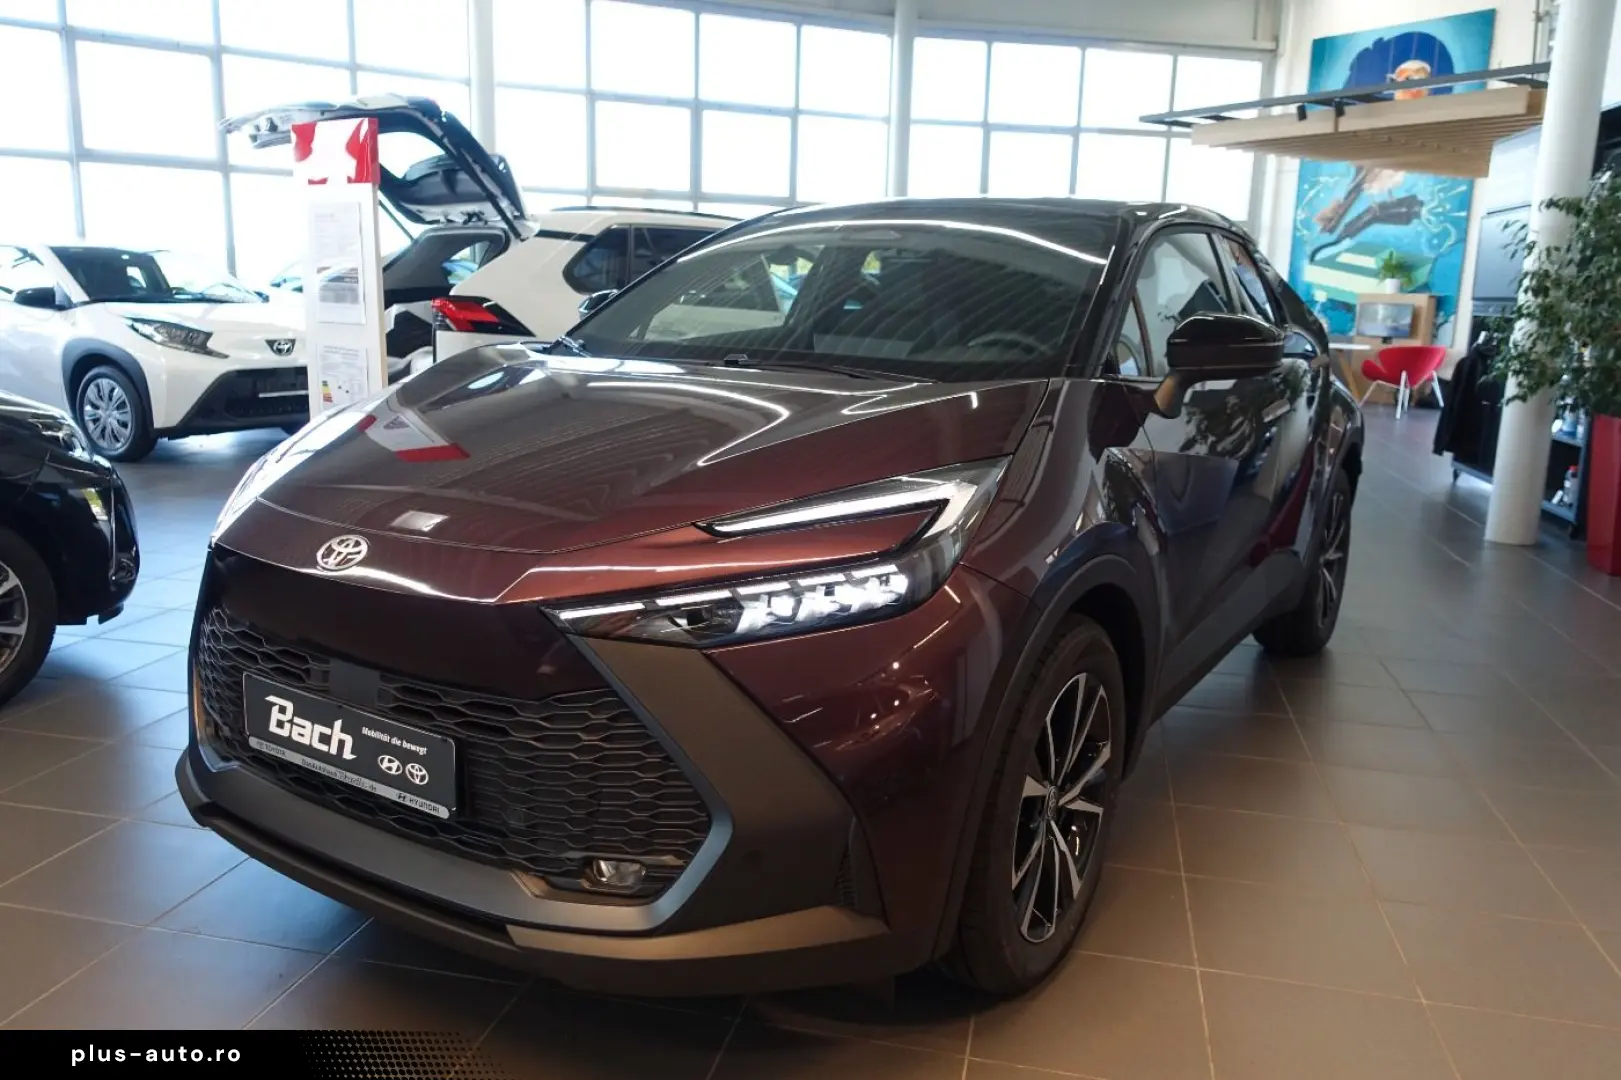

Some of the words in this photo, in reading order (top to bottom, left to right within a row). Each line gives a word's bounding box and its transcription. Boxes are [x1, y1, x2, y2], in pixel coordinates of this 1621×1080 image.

[264, 695, 358, 760] Bach
[361, 726, 391, 743] Mobilität
[390, 736, 402, 747] die
[402, 740, 428, 756] bewegt
[409, 796, 440, 813] HYUNDAI
